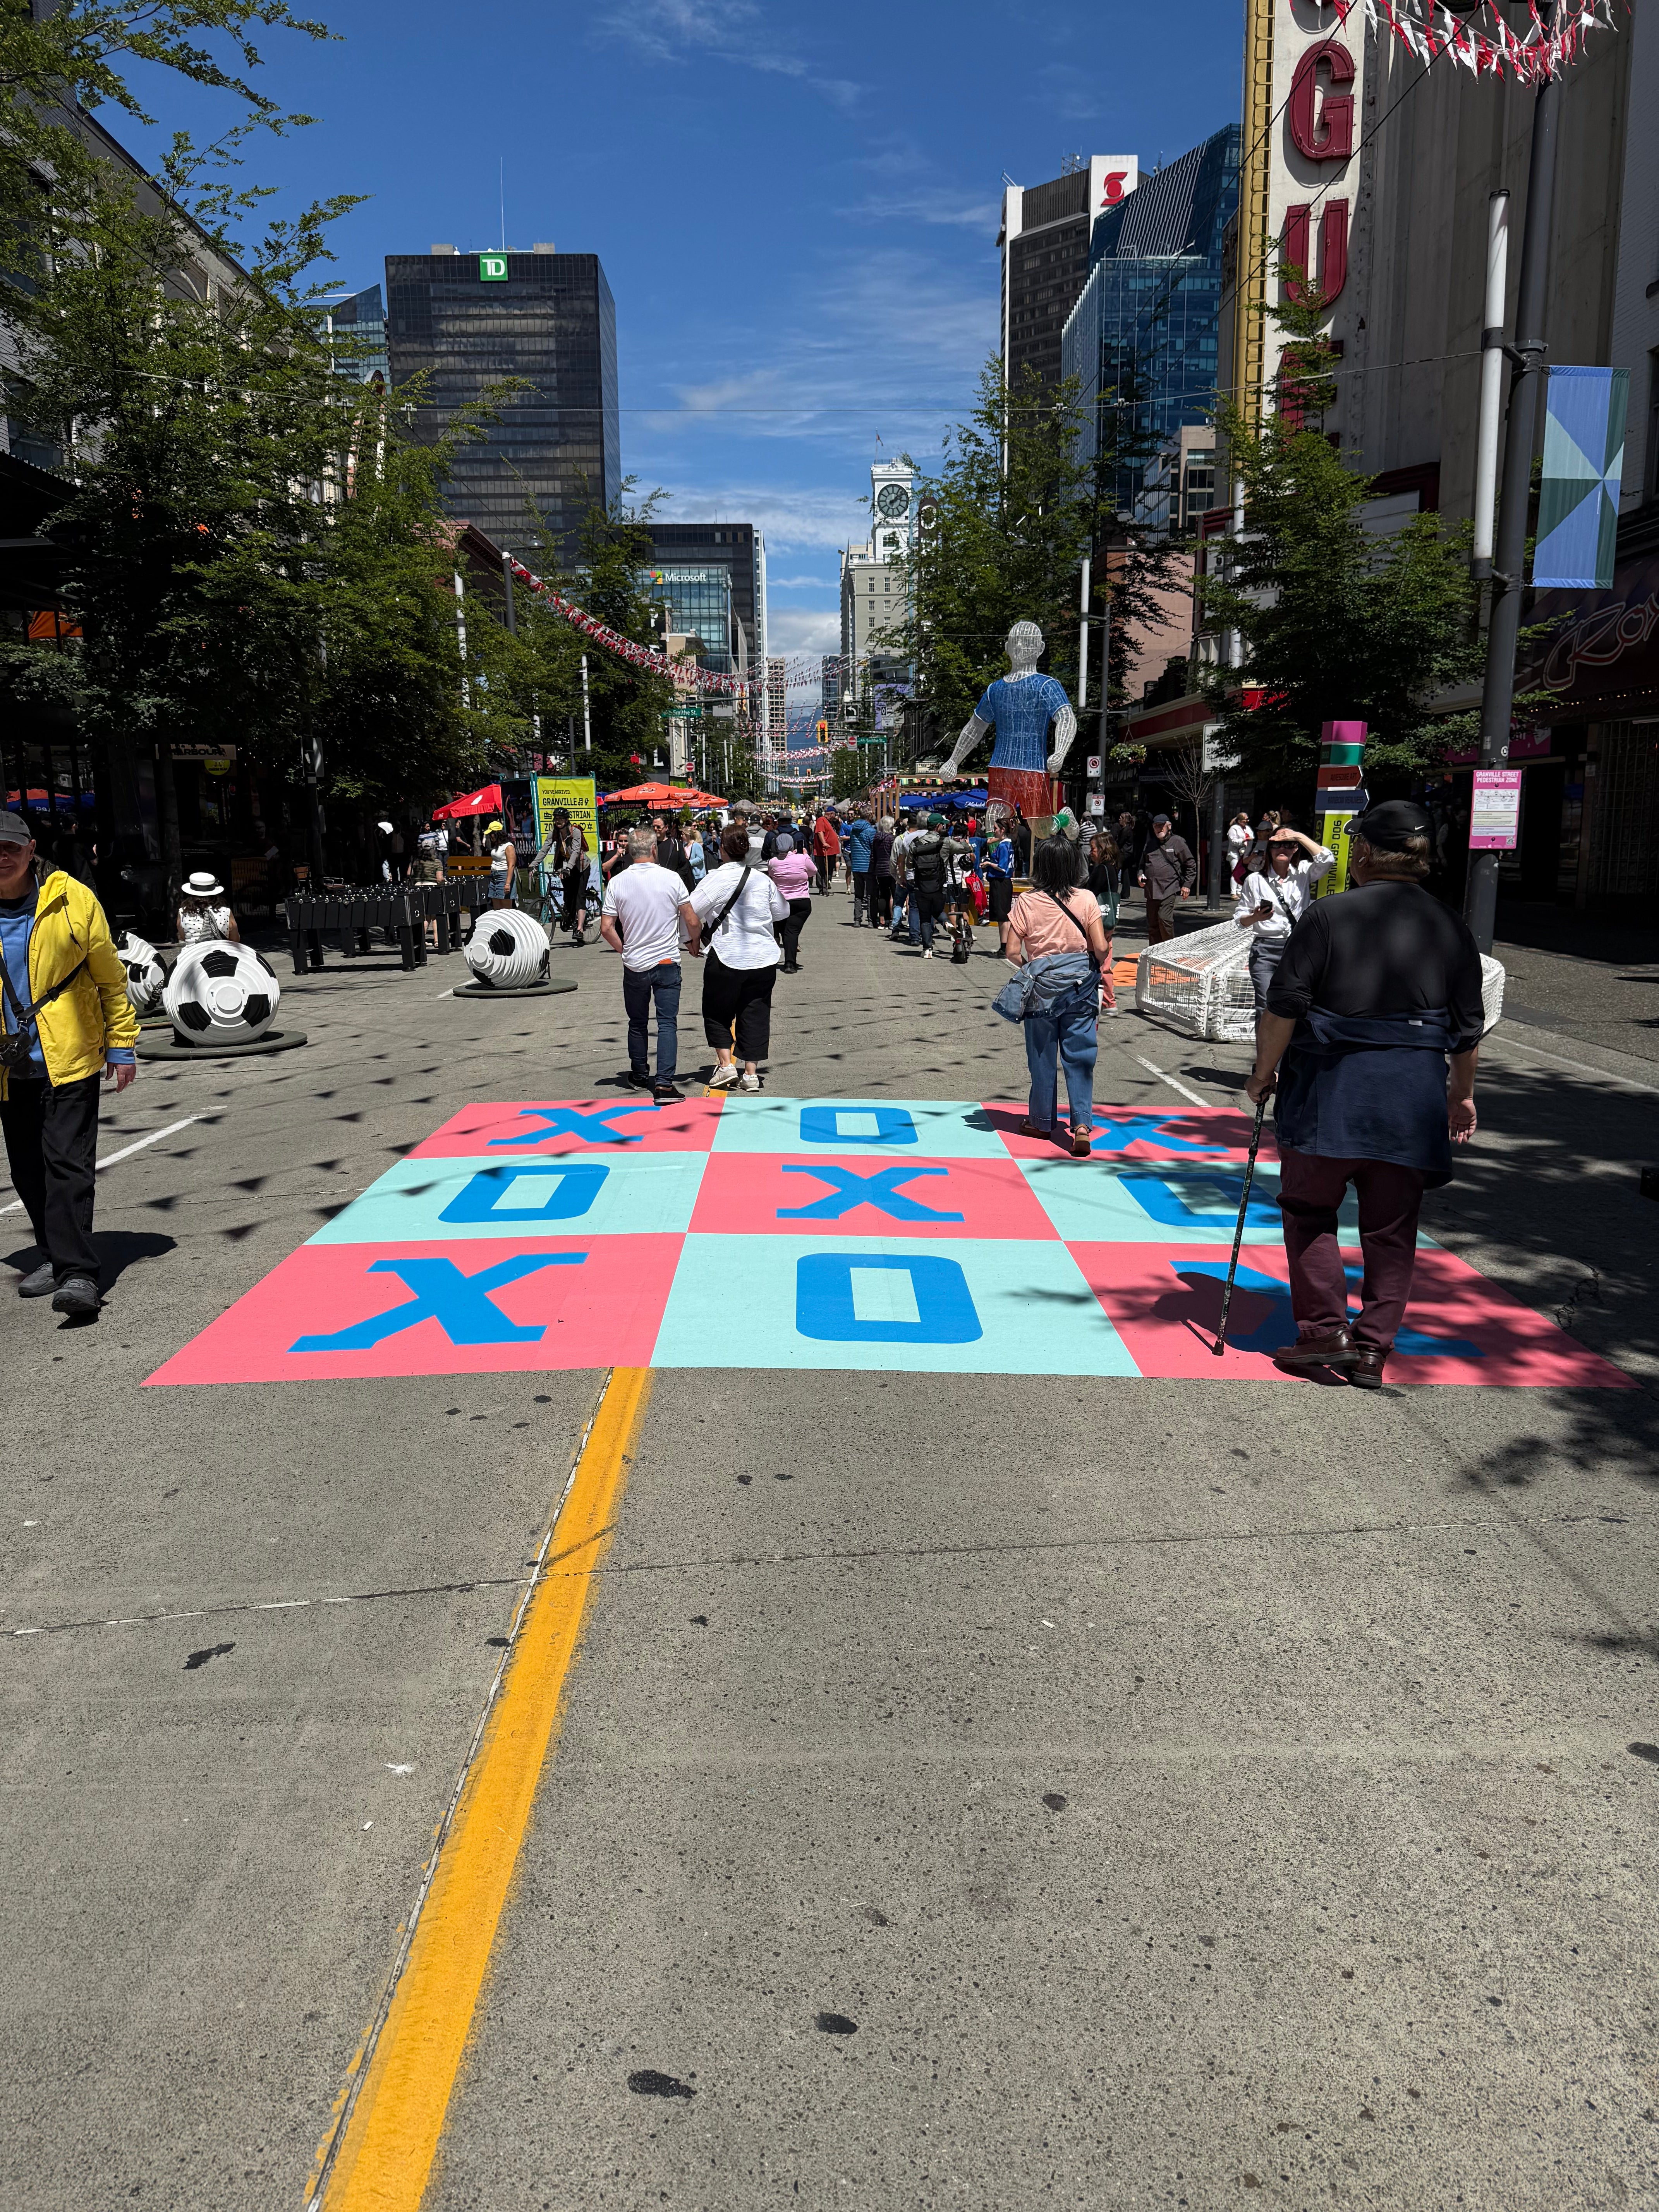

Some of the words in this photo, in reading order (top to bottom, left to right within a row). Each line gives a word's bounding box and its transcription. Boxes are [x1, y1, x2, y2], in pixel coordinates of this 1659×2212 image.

[482, 259, 505, 276] TD
[665, 573, 707, 582] Microsoft
[543, 798, 577, 806] GRANVILLE
[1332, 820, 1342, 840] 900
[776, 1166, 964, 1222] X
[289, 1253, 588, 1352] X
